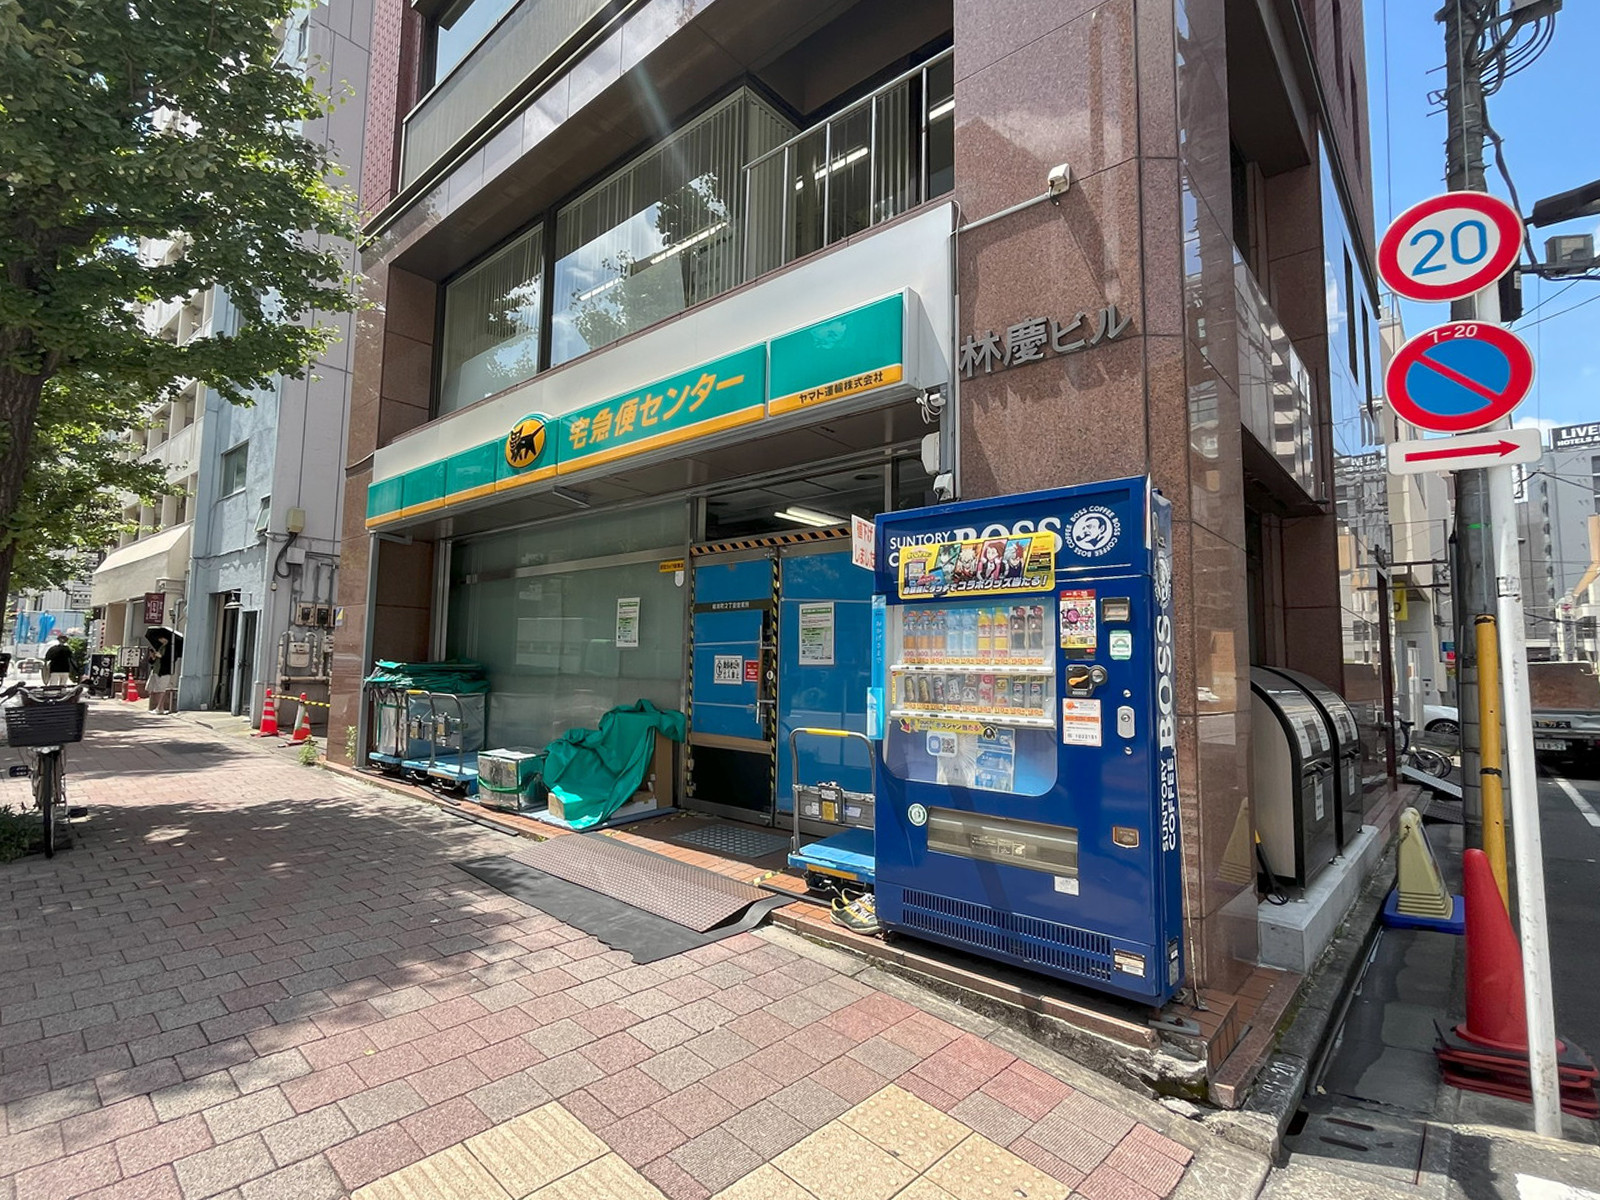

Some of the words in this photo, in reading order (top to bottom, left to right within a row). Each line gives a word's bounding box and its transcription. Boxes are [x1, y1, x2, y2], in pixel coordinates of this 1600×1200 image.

[1409, 219, 1486, 277] 20
[959, 303, 1132, 378] 林慶ビル
[1427, 324, 1478, 344] 7-20
[798, 370, 885, 406] ヤマト運輸株式会社
[569, 372, 746, 450] 宅急便センター
[1557, 437, 1591, 447] HOTELS
[1070, 507, 1088, 522] BOSS
[1088, 505, 1116, 518] COFFEE
[857, 520, 874, 543] 値下げ
[1064, 524, 1076, 549] COFFEE
[1111, 517, 1121, 536] BOSS
[889, 530, 951, 550] SUNTORY
[1094, 537, 1118, 557] COFFEE
[1073, 547, 1092, 558] BOSS
[1157, 614, 1174, 751] BOSS
[1161, 759, 1169, 852] SUNTORY
[1168, 758, 1177, 850] COFFEE
